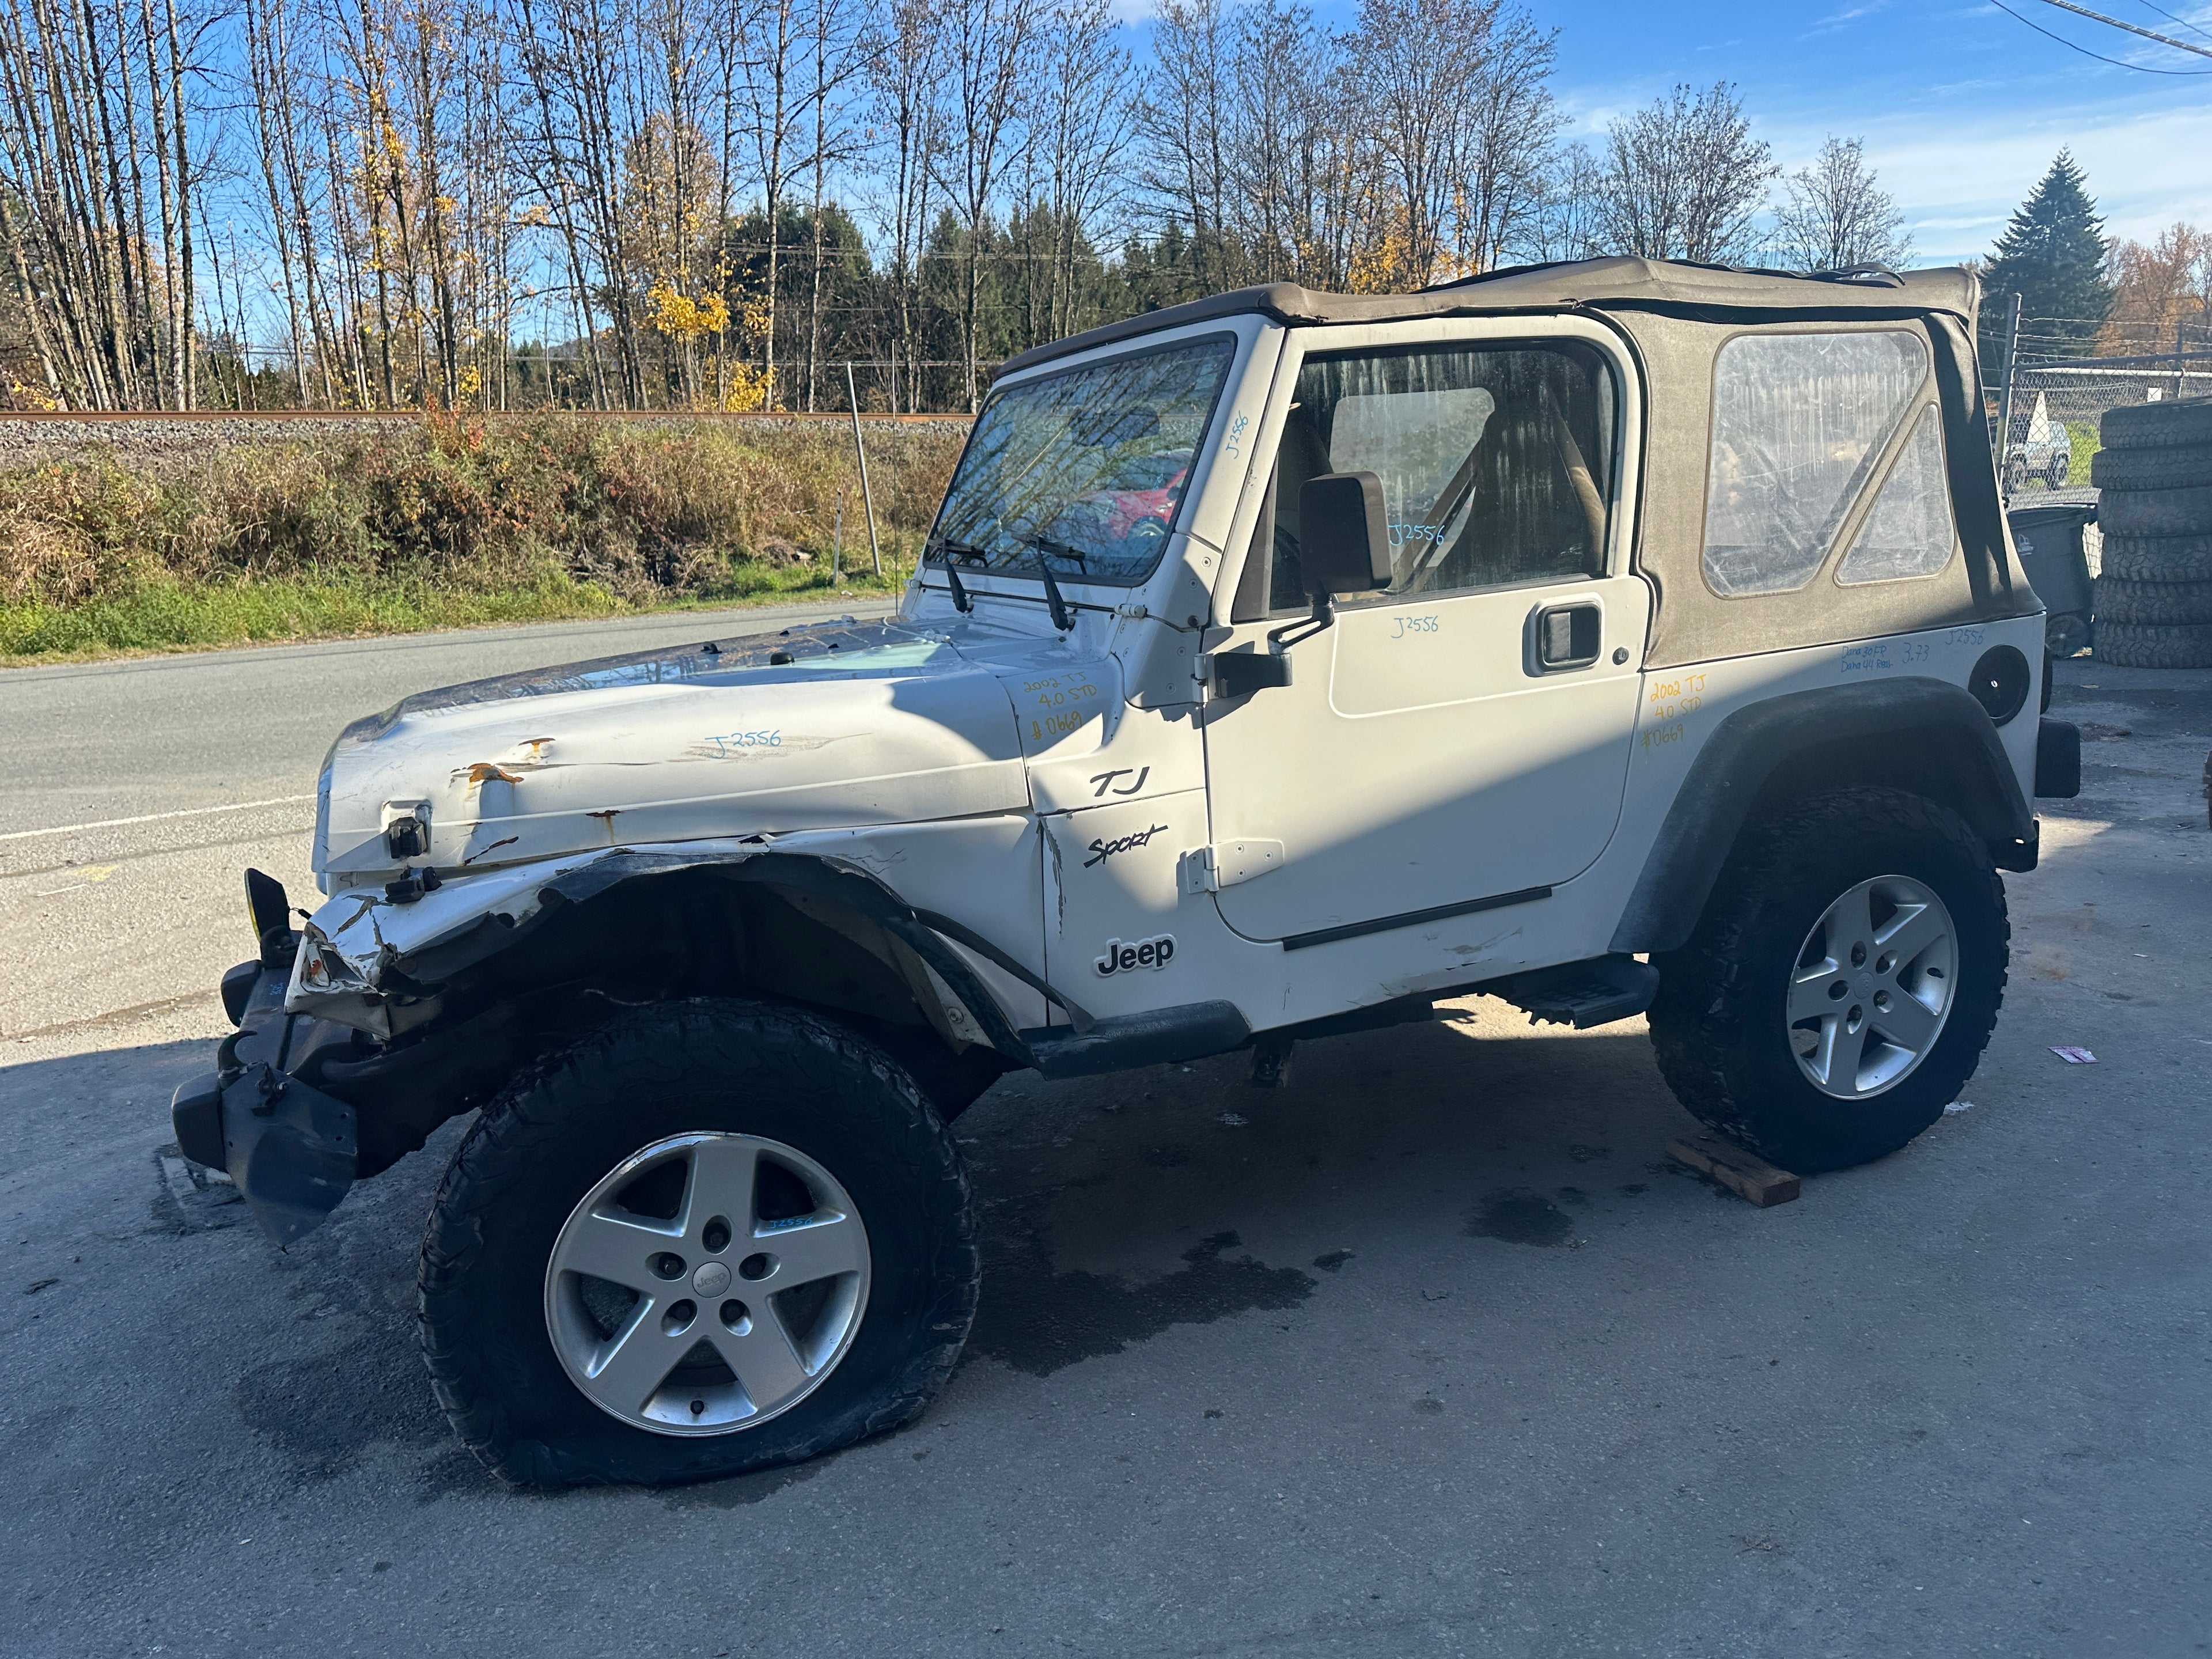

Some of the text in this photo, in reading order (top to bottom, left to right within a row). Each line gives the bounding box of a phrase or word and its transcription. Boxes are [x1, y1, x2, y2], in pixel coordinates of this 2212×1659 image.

[1226, 411, 1249, 459] J2556
[1388, 524, 1445, 546] J2556
[1391, 615, 1439, 639] J2556
[1945, 628, 1986, 645] J2556
[1903, 642, 1930, 663] 3.73
[1023, 671, 1086, 693] 2002 TJ
[1650, 674, 1707, 702] 2002 TJ
[1038, 684, 1097, 709] 4.0 STD
[1680, 696, 1701, 716] STD
[704, 729, 782, 759] J2556
[1090, 766, 1150, 797] TJ
[1098, 937, 1175, 975] Jeep
[697, 1272, 727, 1289] Jeep
